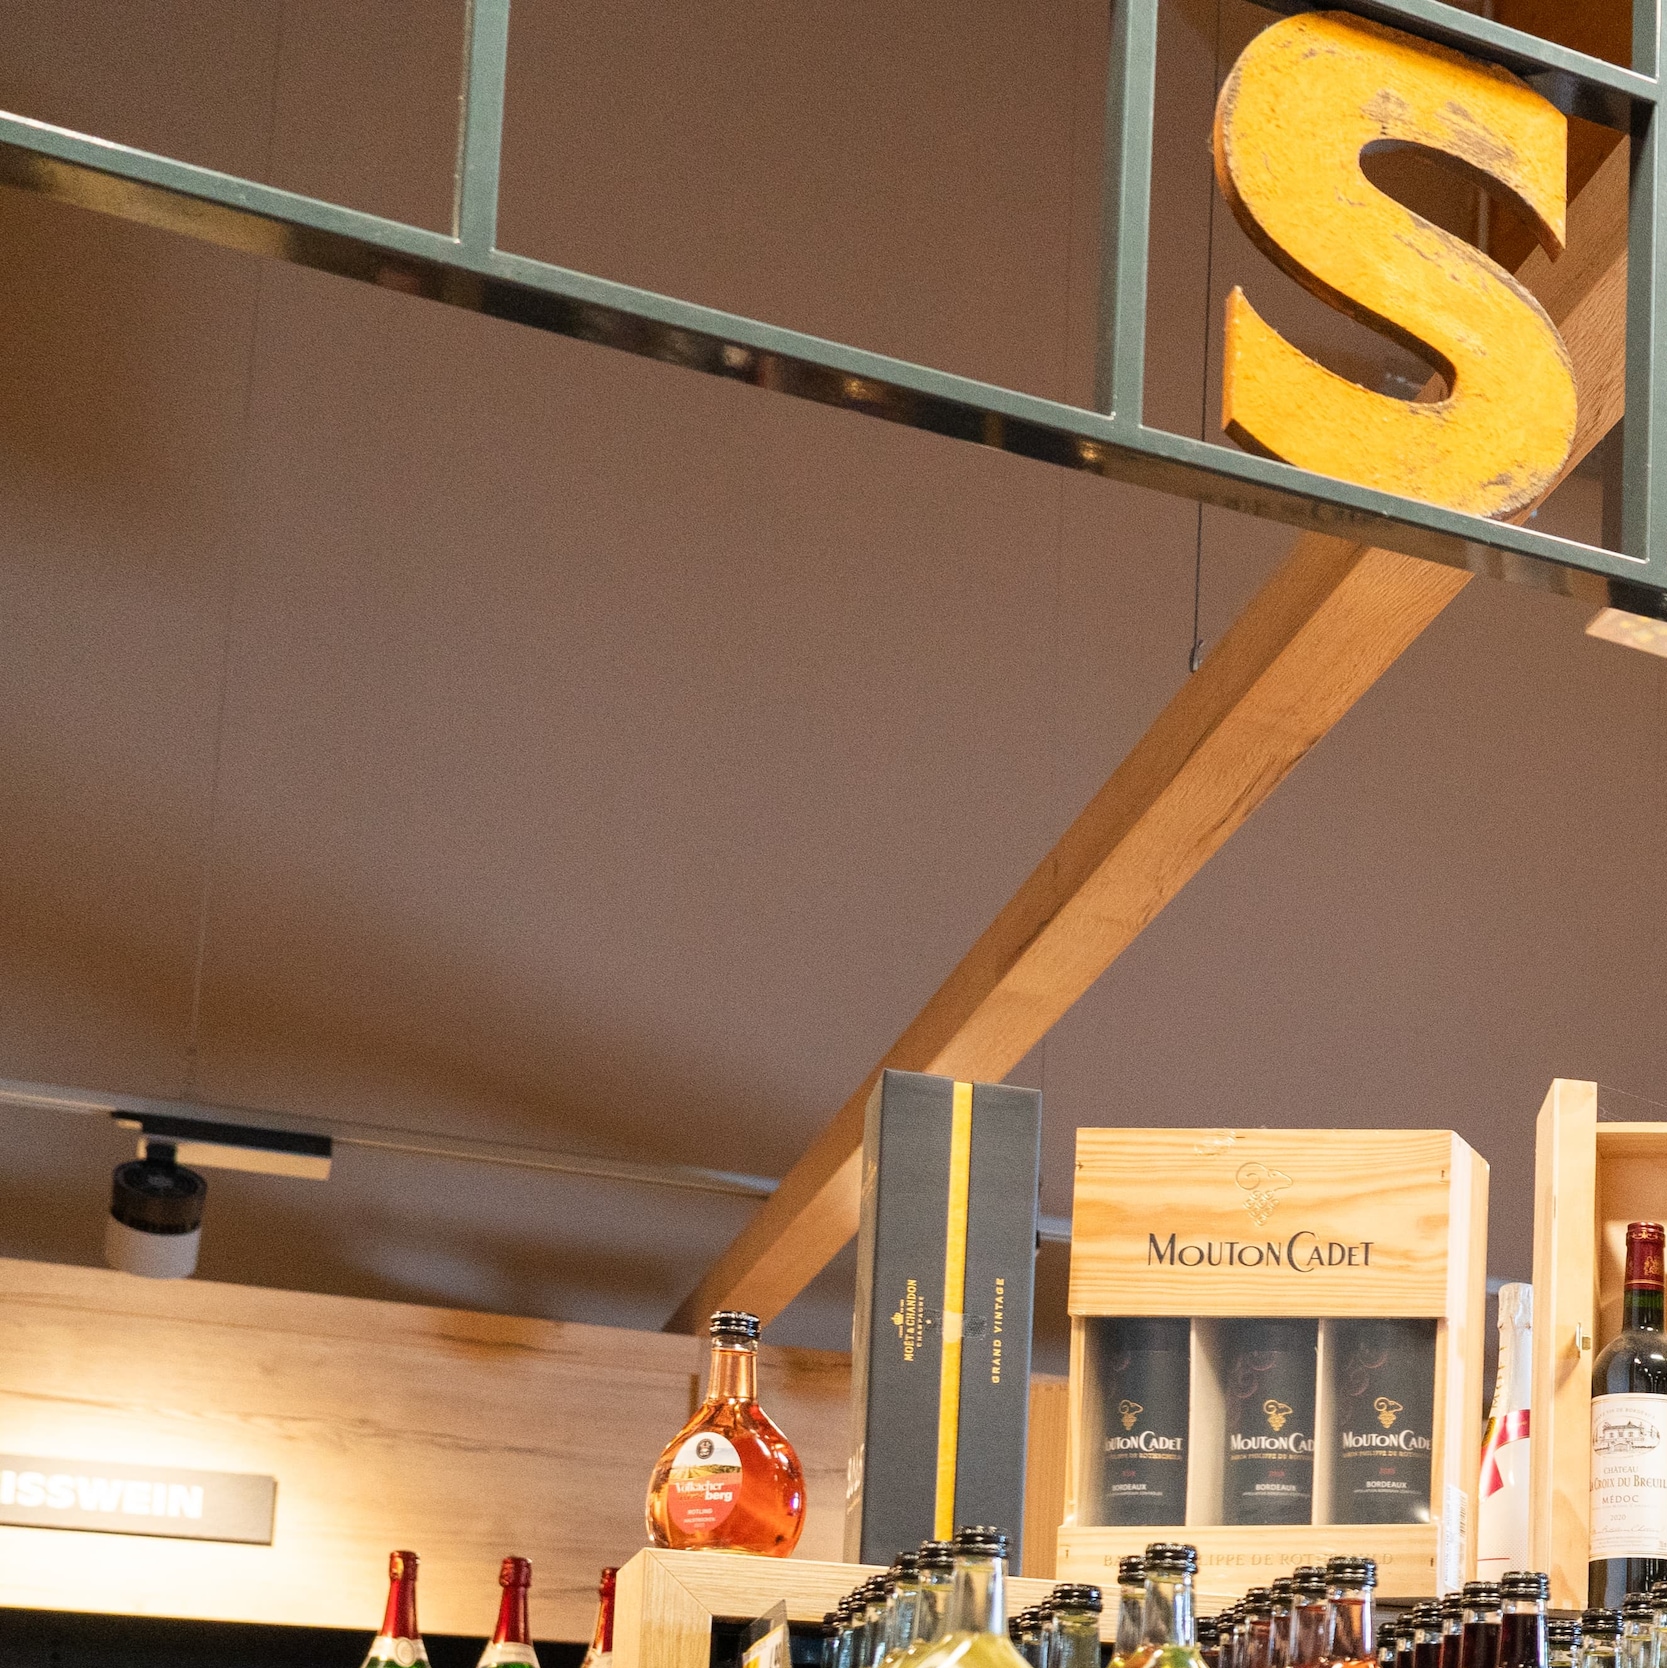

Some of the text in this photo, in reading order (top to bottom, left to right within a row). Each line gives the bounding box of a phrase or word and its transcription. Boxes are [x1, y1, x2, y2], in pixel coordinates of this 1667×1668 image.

[906, 1278, 917, 1326] CHANDON
[992, 1278, 1005, 1383] GRAND VINTAGE
[1603, 1466, 1639, 1475] CHÂTEAU
[1255, 1482, 1296, 1491] BORDEAUX
[1366, 1480, 1408, 1489] BORDEAUX
[705, 1491, 733, 1502] berg
[1602, 1495, 1640, 1505] MÉDOC
